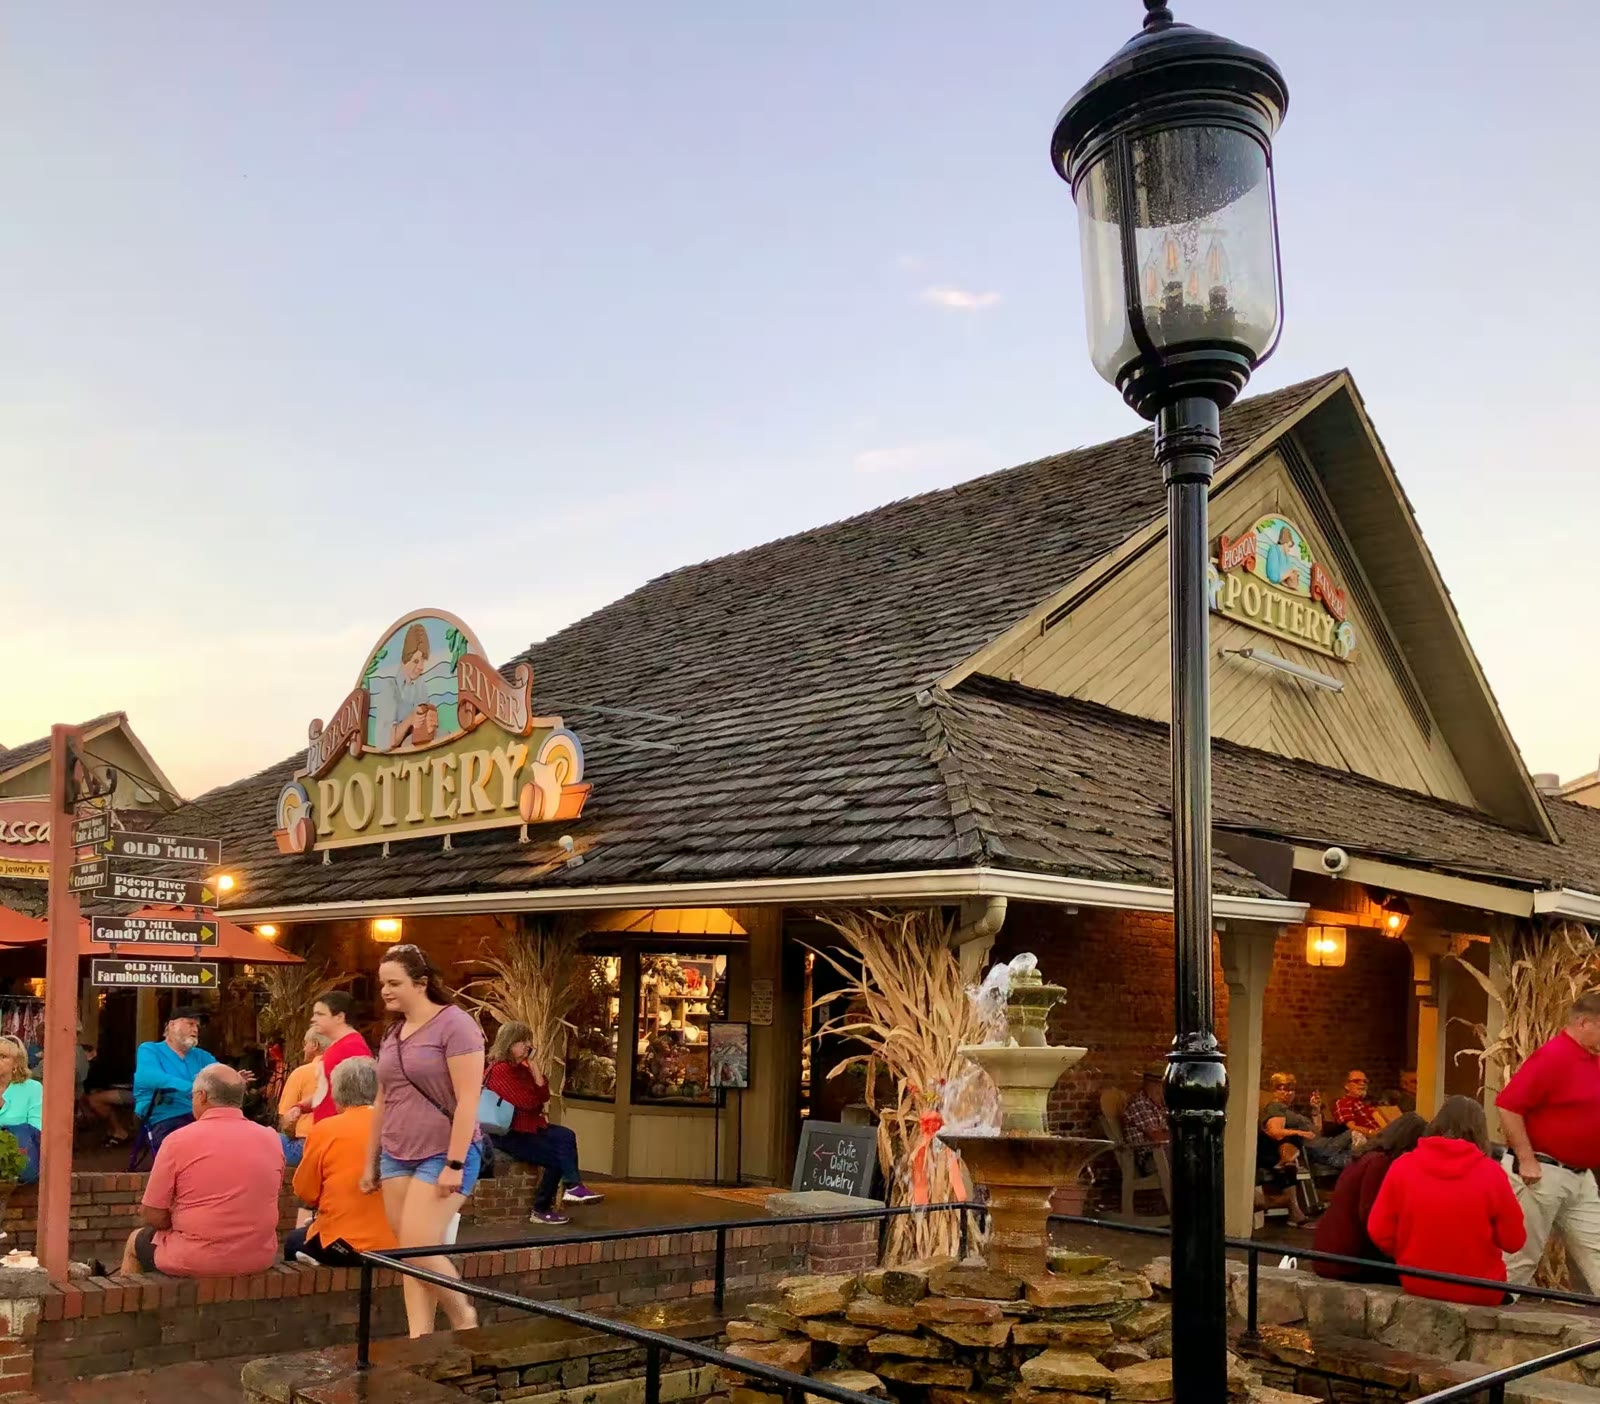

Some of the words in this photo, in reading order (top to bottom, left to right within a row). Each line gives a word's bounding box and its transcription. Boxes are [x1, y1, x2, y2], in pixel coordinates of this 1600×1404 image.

[1224, 536, 1256, 569] PIGEON
[1315, 566, 1343, 617] RIVER
[1225, 573, 1335, 647] POTTERY
[459, 661, 524, 730] RIVER
[306, 696, 362, 776] PIGEON
[316, 740, 528, 836] POTTERY
[92, 825, 106, 839] Grill
[123, 841, 161, 856] OLD
[167, 845, 208, 861] MILL
[5, 865, 35, 876] jewelry
[38, 865, 44, 873] &
[74, 872, 104, 888] Creamery
[115, 876, 155, 888] Pigeon
[158, 881, 187, 890] River
[114, 884, 187, 903] Pottery
[124, 920, 146, 928] OLD
[149, 921, 174, 930] MILL
[96, 927, 140, 941] Candy
[144, 929, 198, 942] Kitchen
[124, 963, 146, 972] OLD
[149, 964, 174, 973] MILL
[97, 971, 158, 983] Farmhouse
[160, 973, 199, 984] Kitchen
[837, 1140, 857, 1158] Cute
[829, 1155, 859, 1173] Clothes
[818, 1168, 855, 1197] Jewelry
